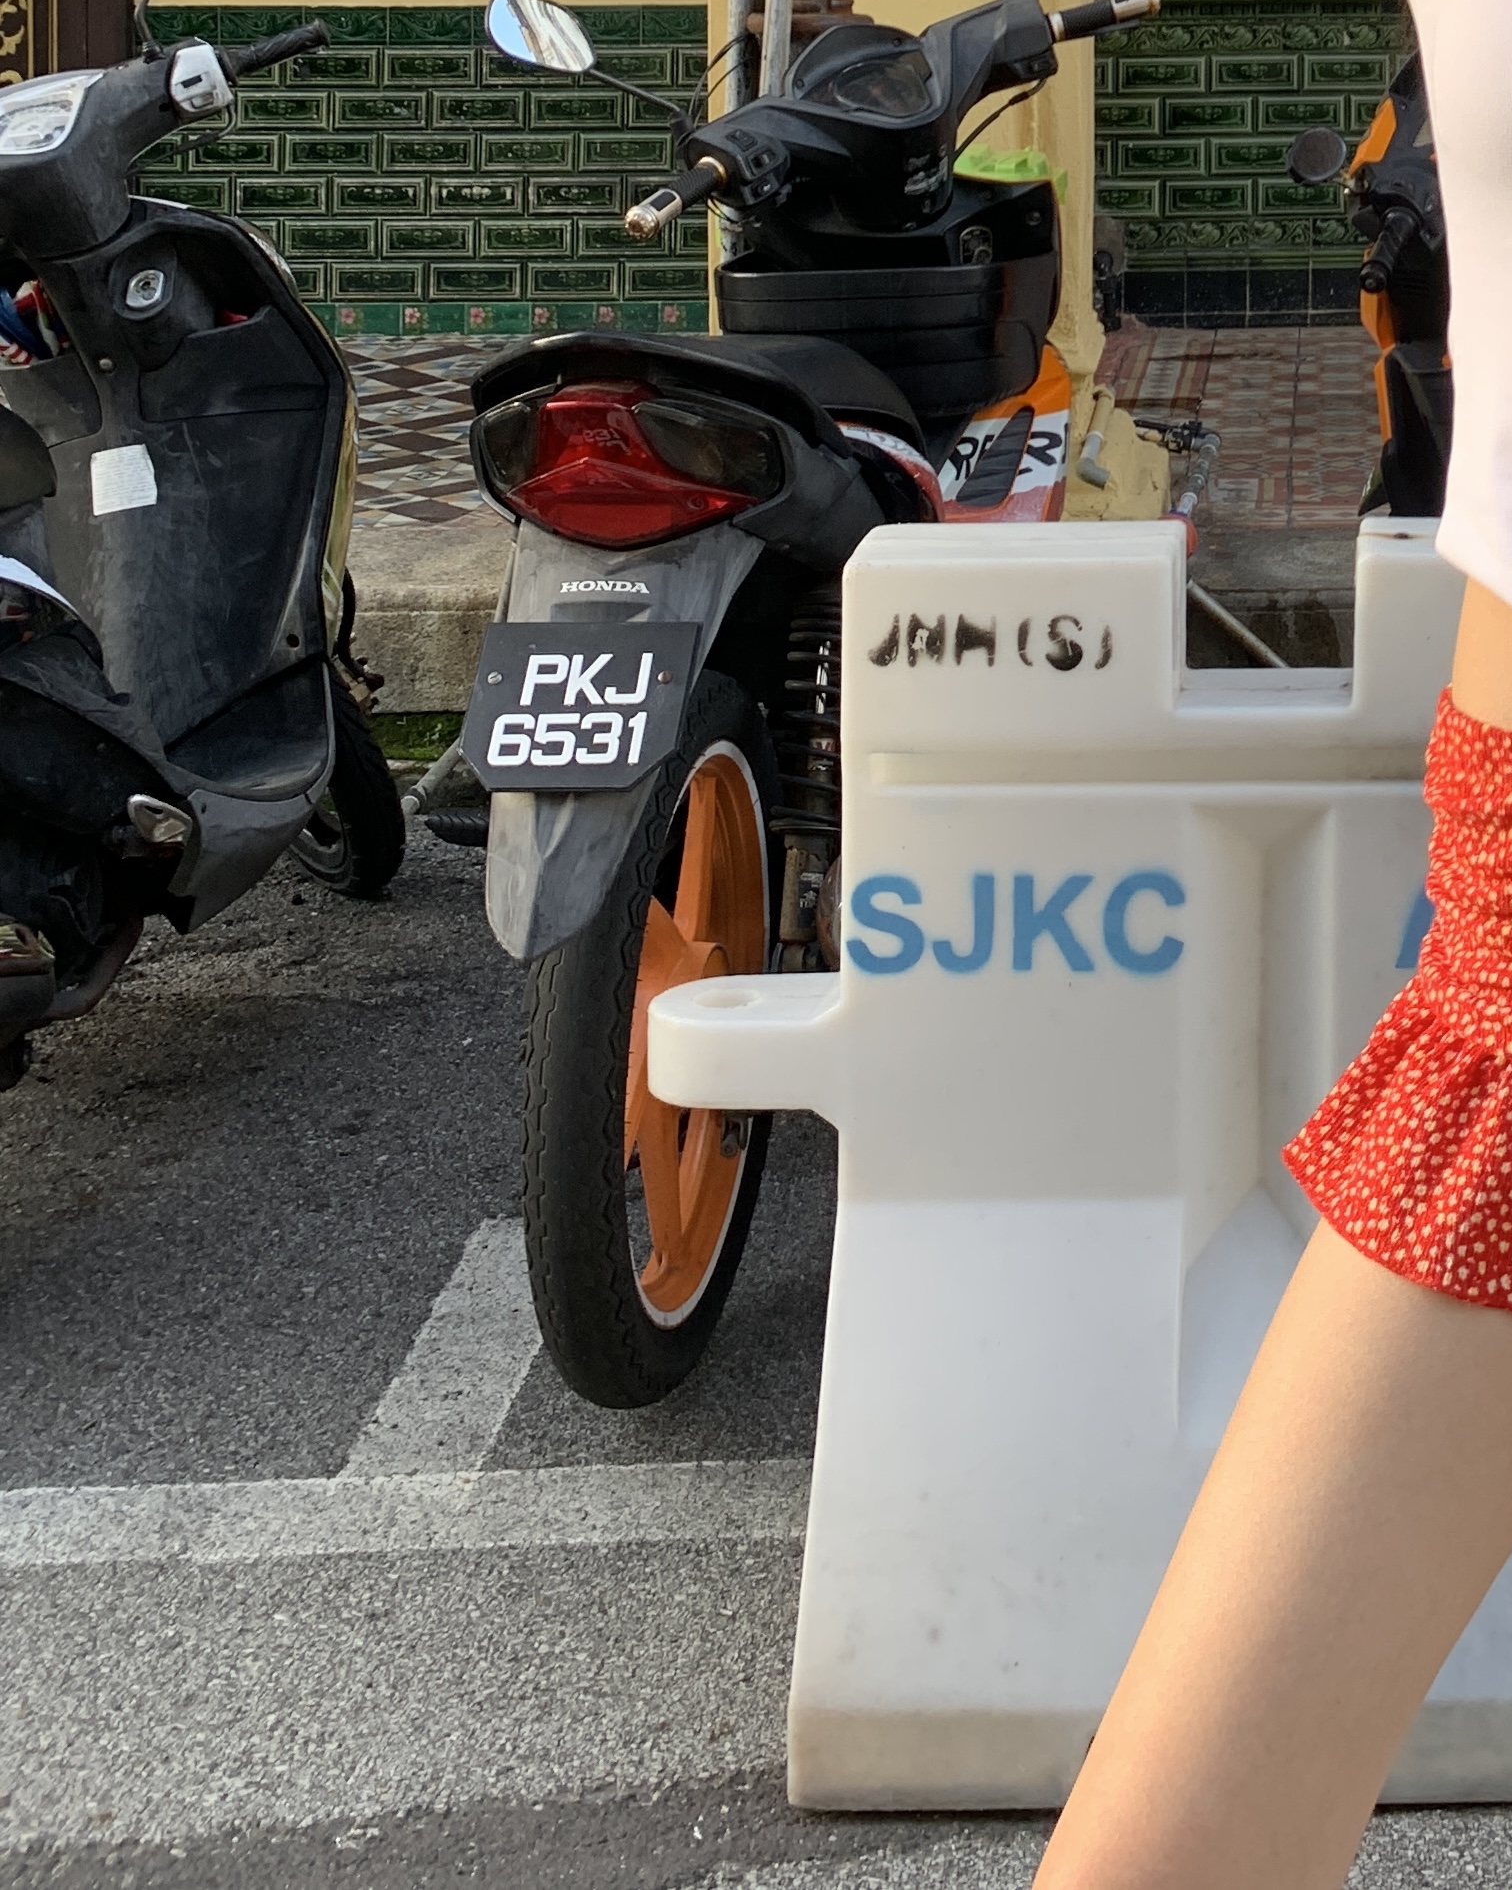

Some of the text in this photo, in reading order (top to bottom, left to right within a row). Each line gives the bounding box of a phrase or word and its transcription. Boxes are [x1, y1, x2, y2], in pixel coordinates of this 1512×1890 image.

[560, 580, 649, 594] HONDA
[519, 652, 654, 706] PKJ
[487, 711, 648, 767] 6531
[846, 872, 1186, 975] SJKC
